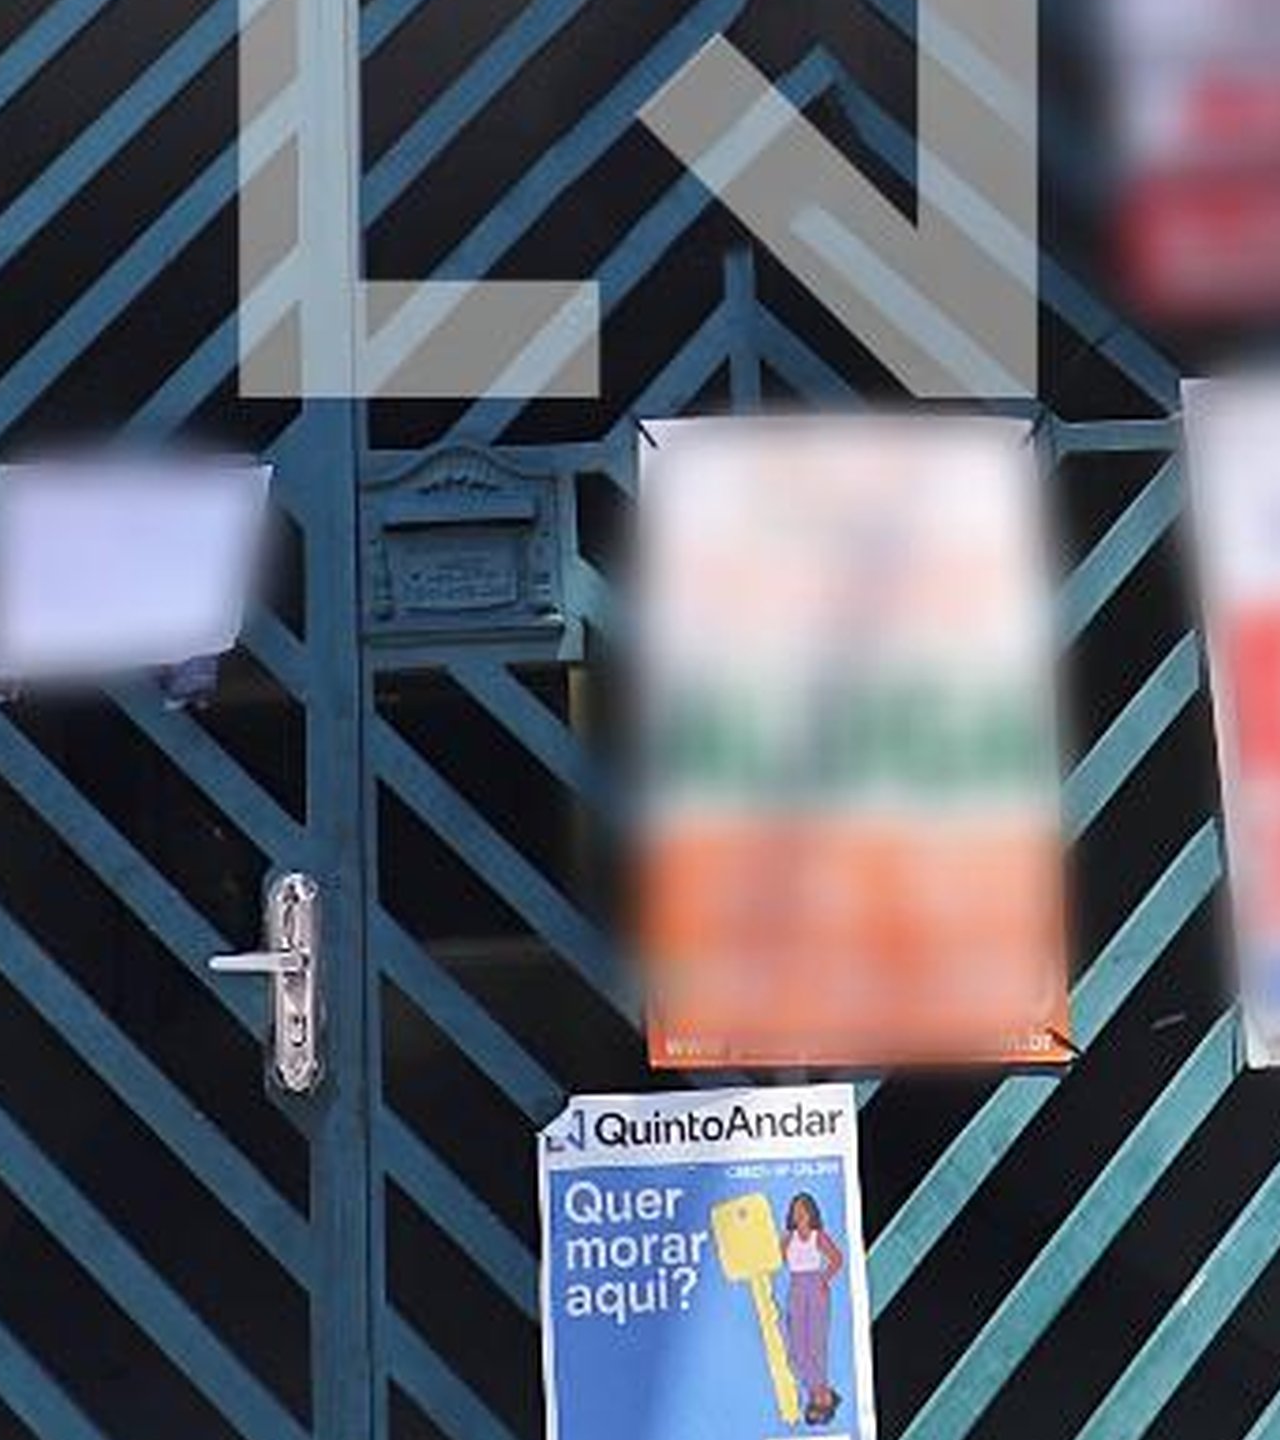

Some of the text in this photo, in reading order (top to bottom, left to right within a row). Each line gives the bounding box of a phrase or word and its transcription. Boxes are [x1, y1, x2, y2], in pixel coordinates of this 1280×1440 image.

[594, 1103, 843, 1148] QuintoAndar
[564, 1180, 684, 1225] Quer
[566, 1230, 709, 1271] morar
[566, 1266, 699, 1326] aqui?
